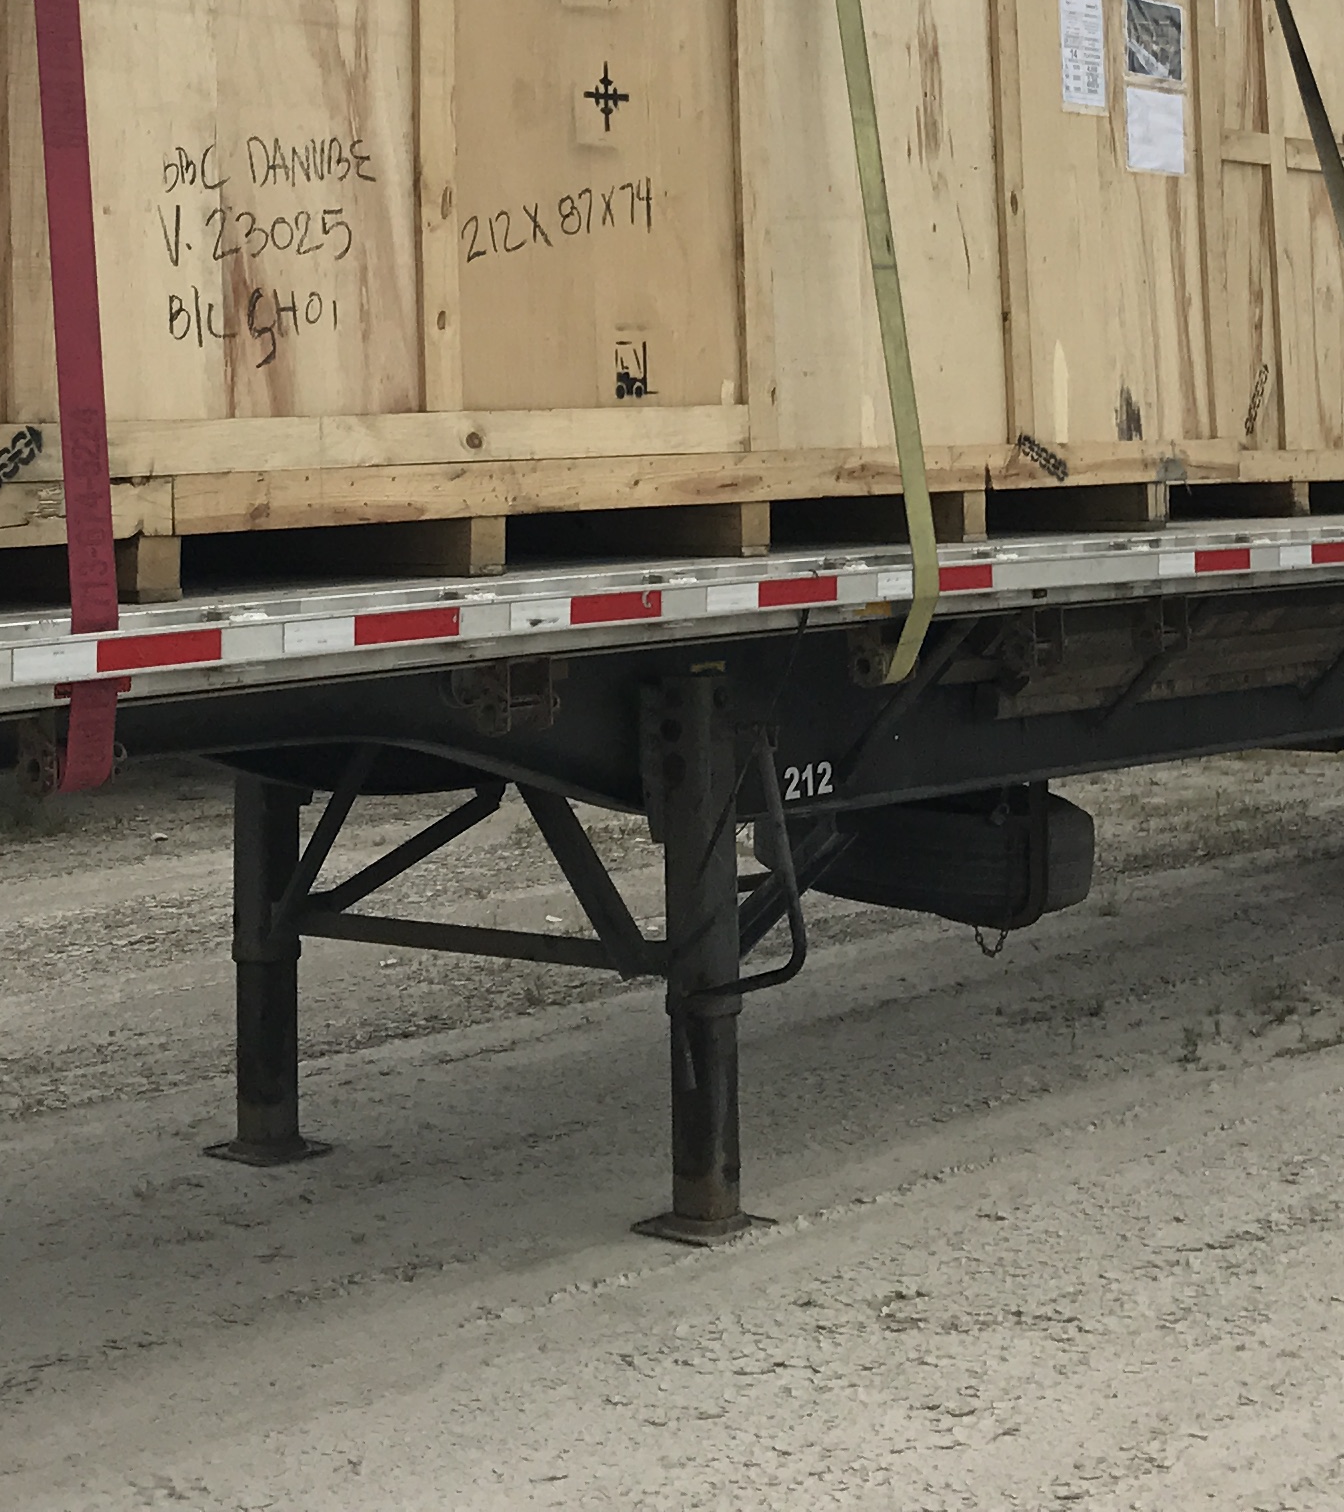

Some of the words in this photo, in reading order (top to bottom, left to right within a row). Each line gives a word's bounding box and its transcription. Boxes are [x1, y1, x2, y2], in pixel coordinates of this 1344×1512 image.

[162, 143, 232, 193] BBC
[246, 135, 377, 188] DANUBE
[204, 206, 353, 262] 23025
[783, 760, 834, 802] 212
